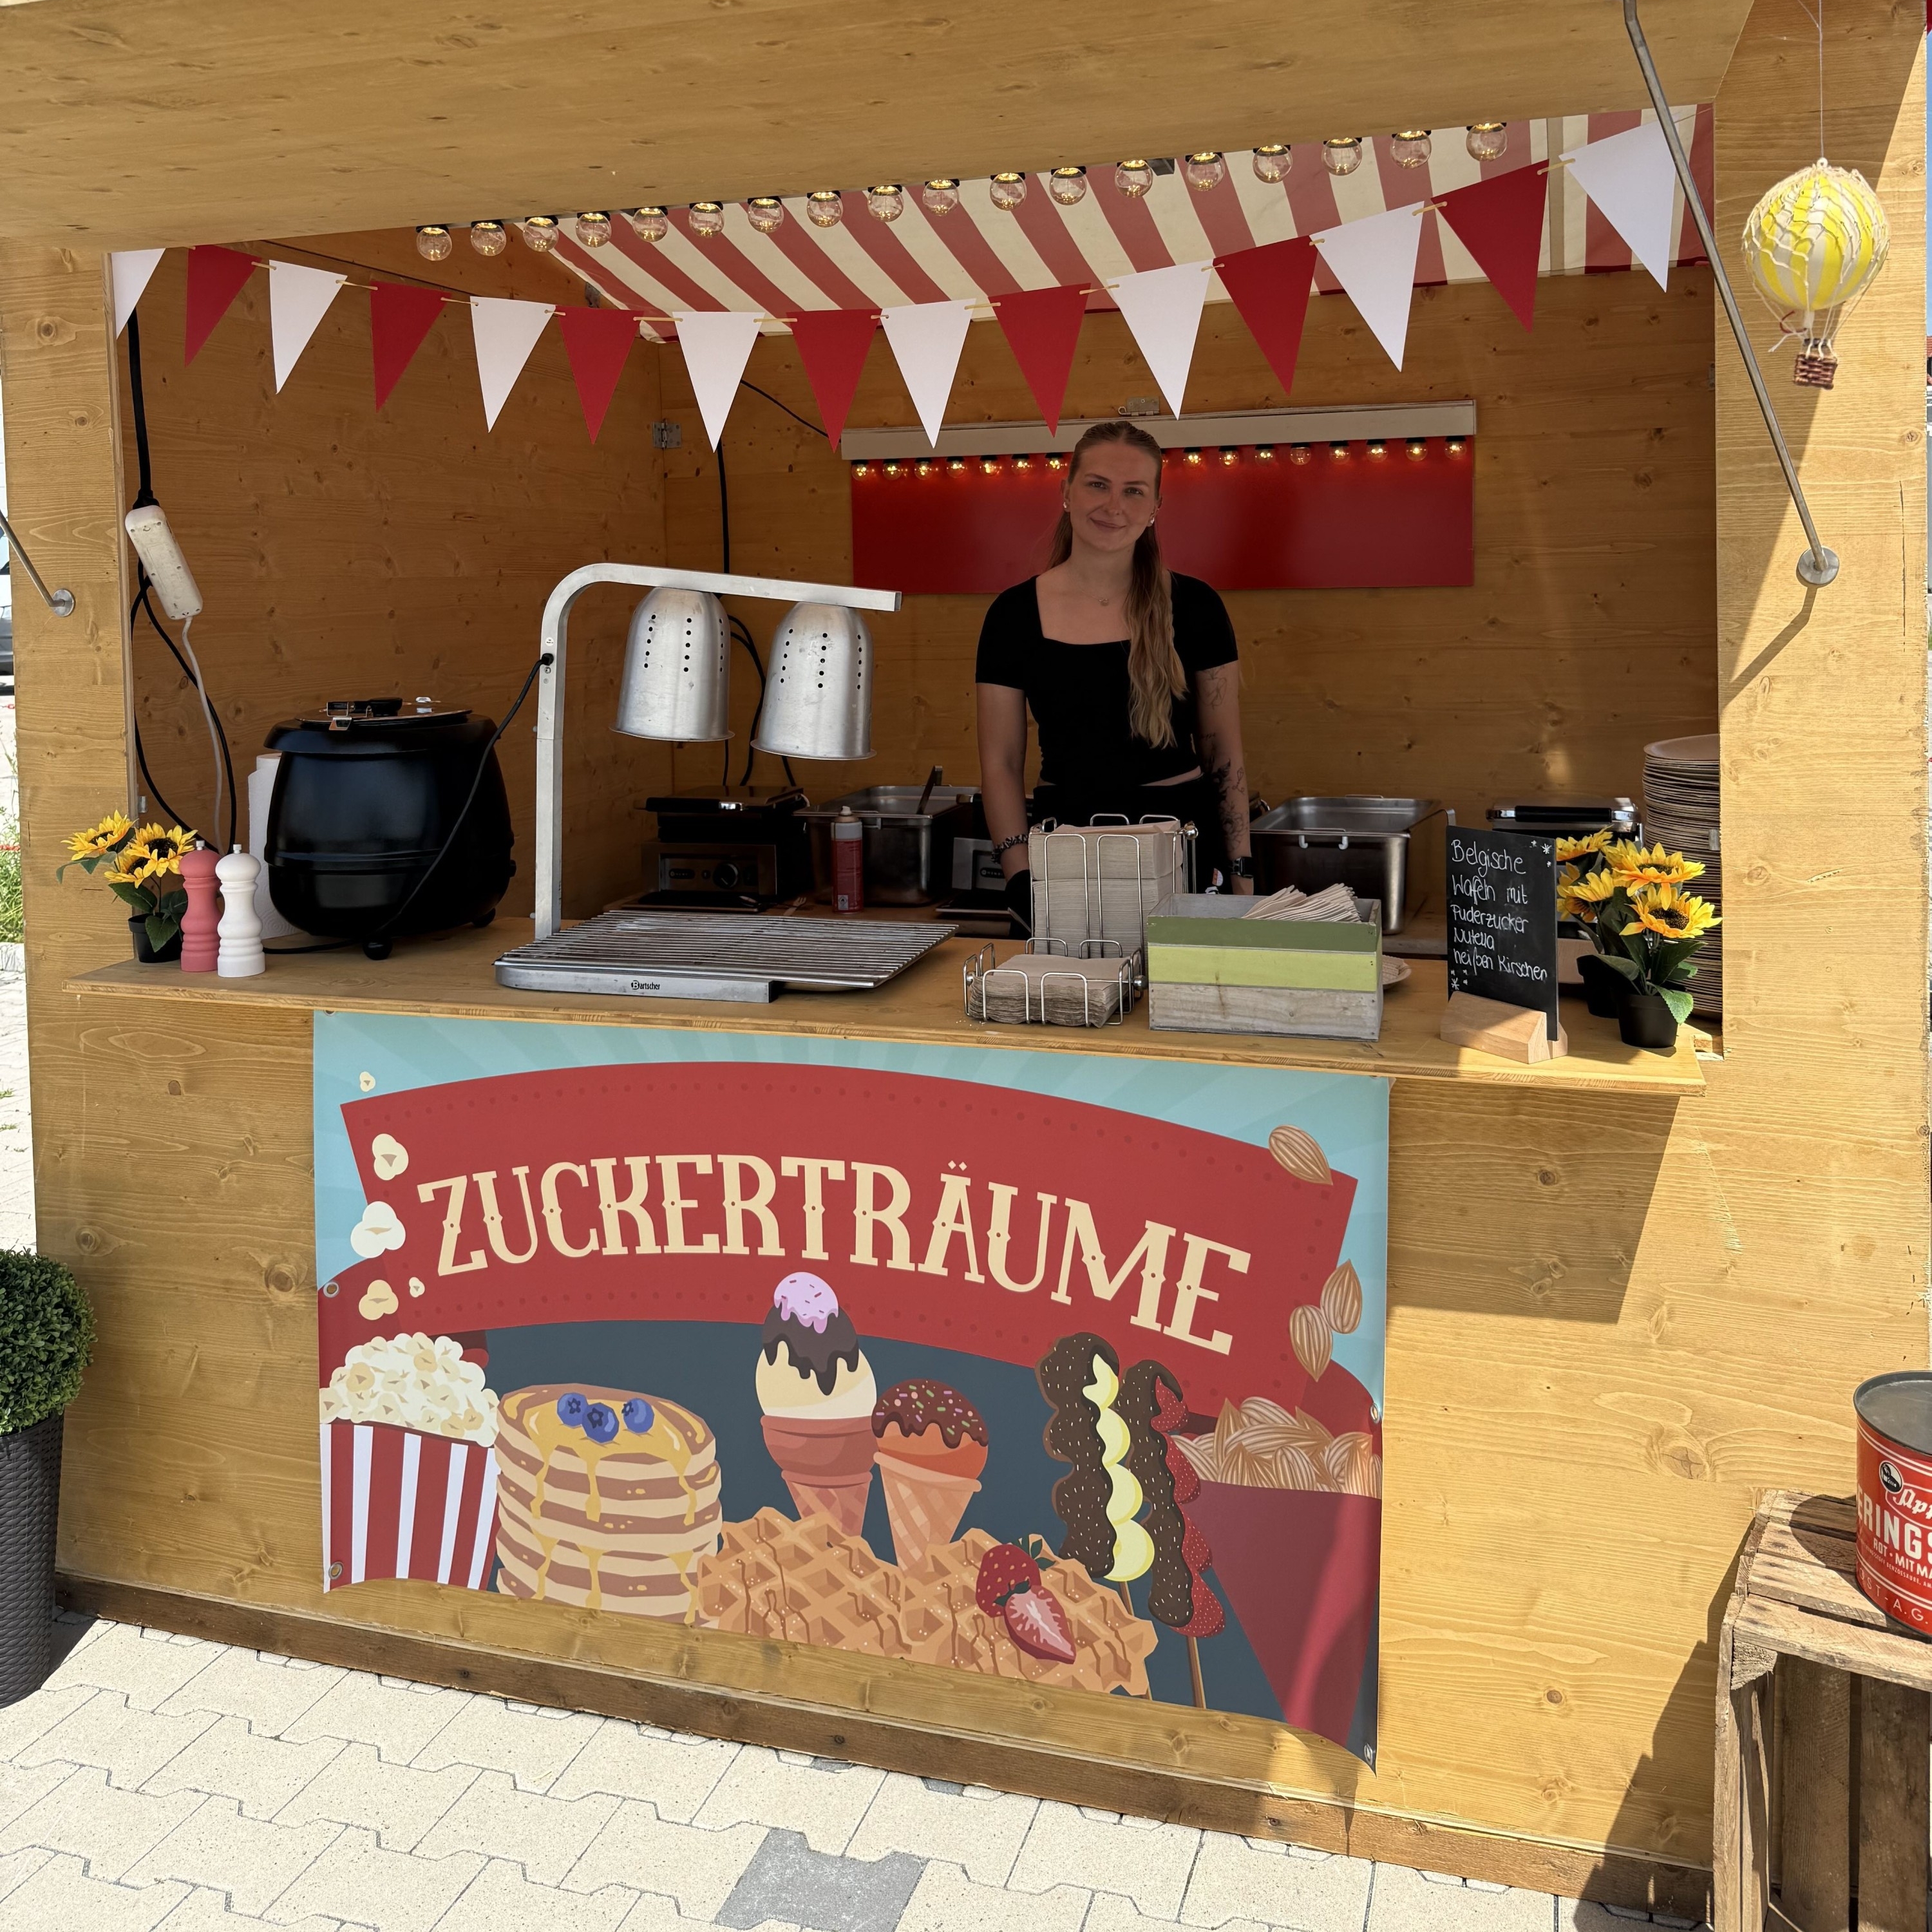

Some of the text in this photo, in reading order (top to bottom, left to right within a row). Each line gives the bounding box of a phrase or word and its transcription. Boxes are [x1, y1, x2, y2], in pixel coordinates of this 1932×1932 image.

[1451, 839, 1526, 877] Belgische
[1506, 884, 1528, 904] mit
[1450, 904, 1529, 933] Puderzucker
[1454, 927, 1495, 951] Nutella
[1454, 947, 1548, 981] heißen Kirschen
[630, 980, 660, 990] Bartscher
[417, 1153, 1251, 1356] ZUCKERTRÄUME
[1856, 1483, 1932, 1565] ERING
[1873, 1537, 1888, 1557] ROT
[1895, 1553, 1915, 1573] MIT
